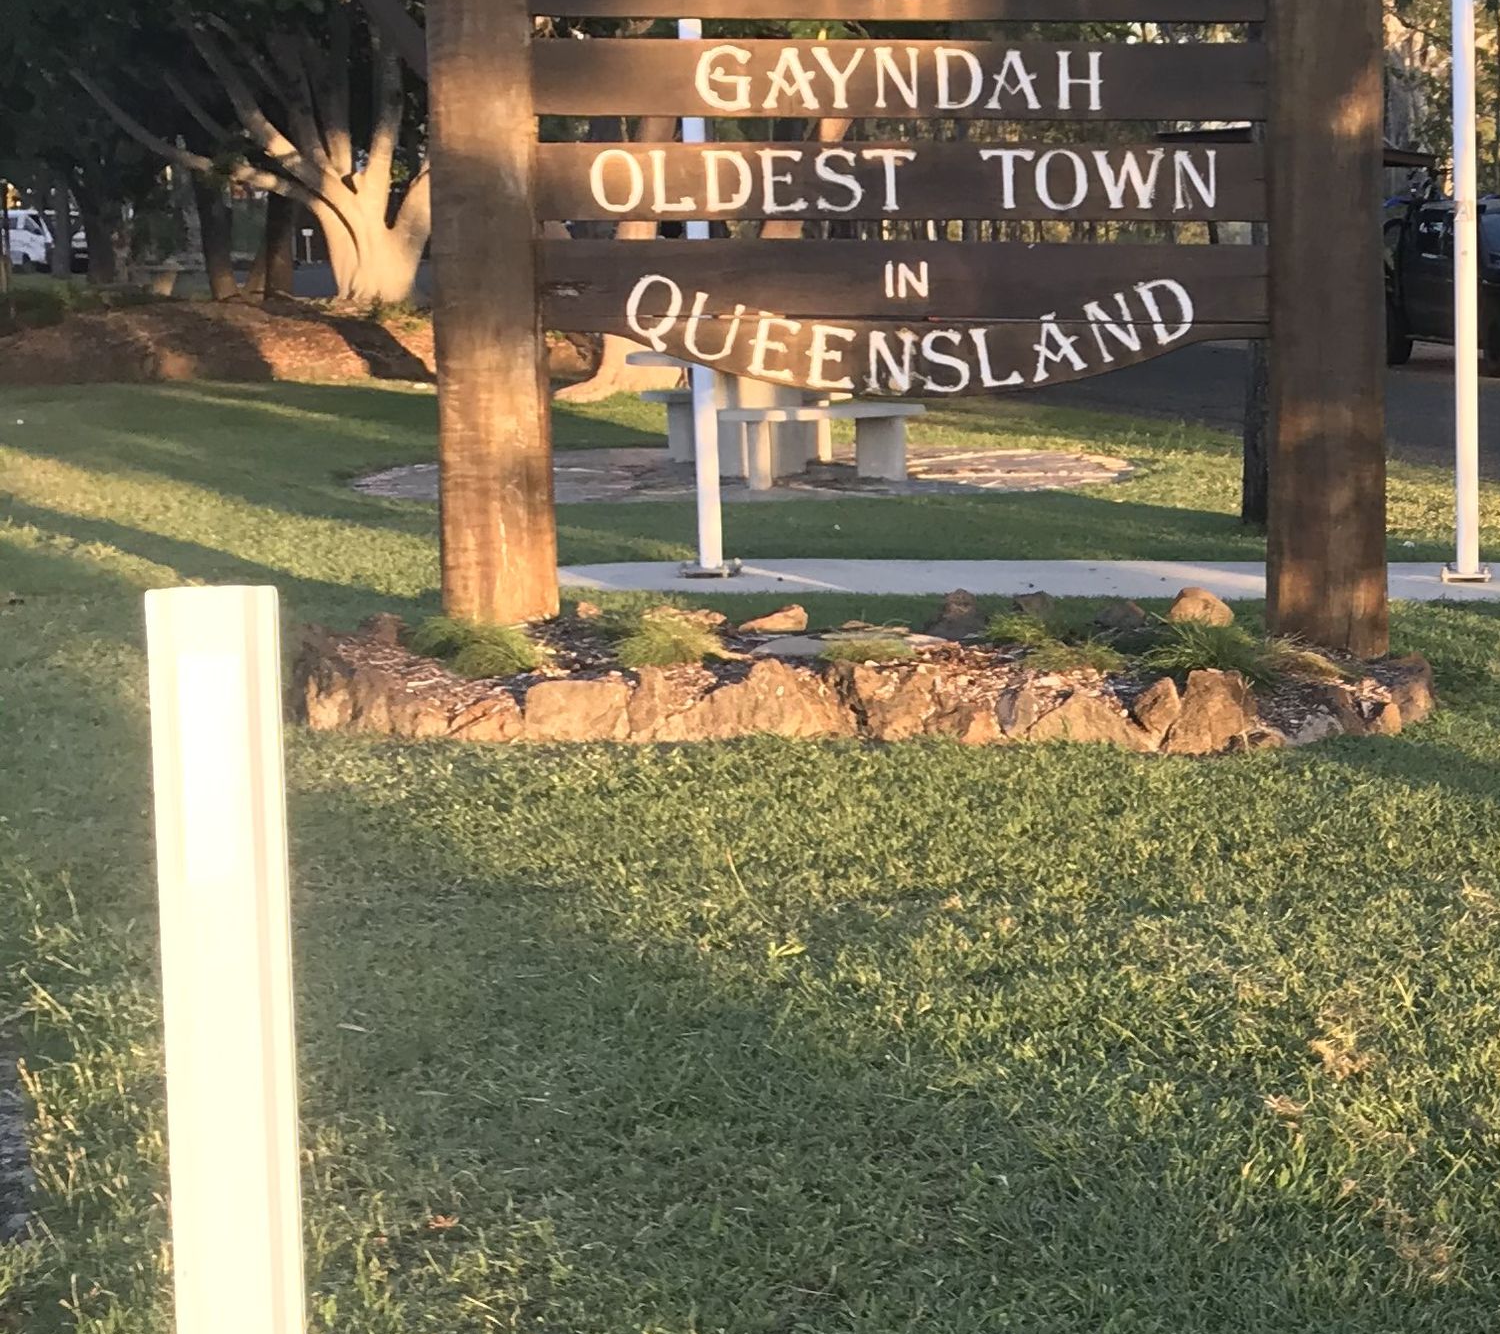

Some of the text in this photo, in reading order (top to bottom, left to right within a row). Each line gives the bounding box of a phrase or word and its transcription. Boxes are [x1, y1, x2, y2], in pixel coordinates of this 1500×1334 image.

[695, 45, 1104, 111] GAYNDAH
[589, 148, 1217, 213] OLDEST TOWN
[885, 261, 929, 299] IN
[626, 274, 1195, 393] QUEENSLAND
